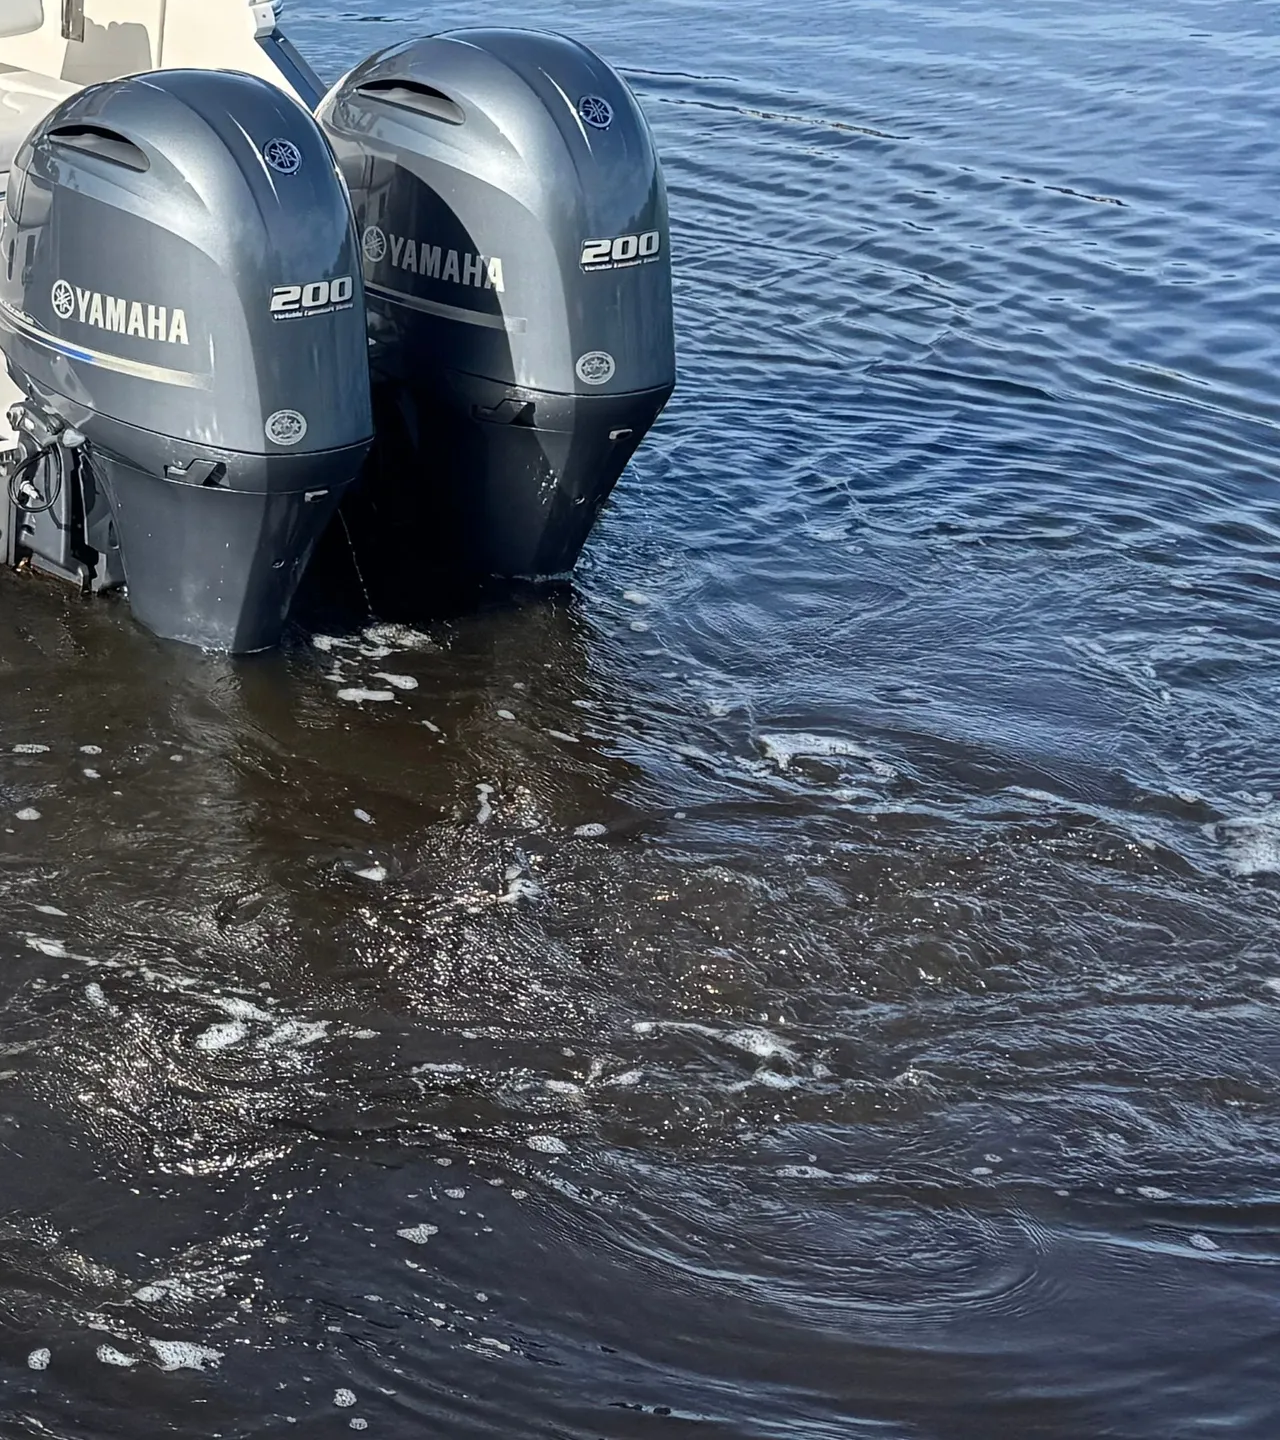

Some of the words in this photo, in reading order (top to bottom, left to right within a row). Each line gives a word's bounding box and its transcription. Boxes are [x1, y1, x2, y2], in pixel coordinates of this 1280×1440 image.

[389, 233, 505, 293] YAMAHA
[581, 231, 660, 264] 200
[75, 286, 190, 345] YAMAHA
[270, 276, 353, 312] 200
